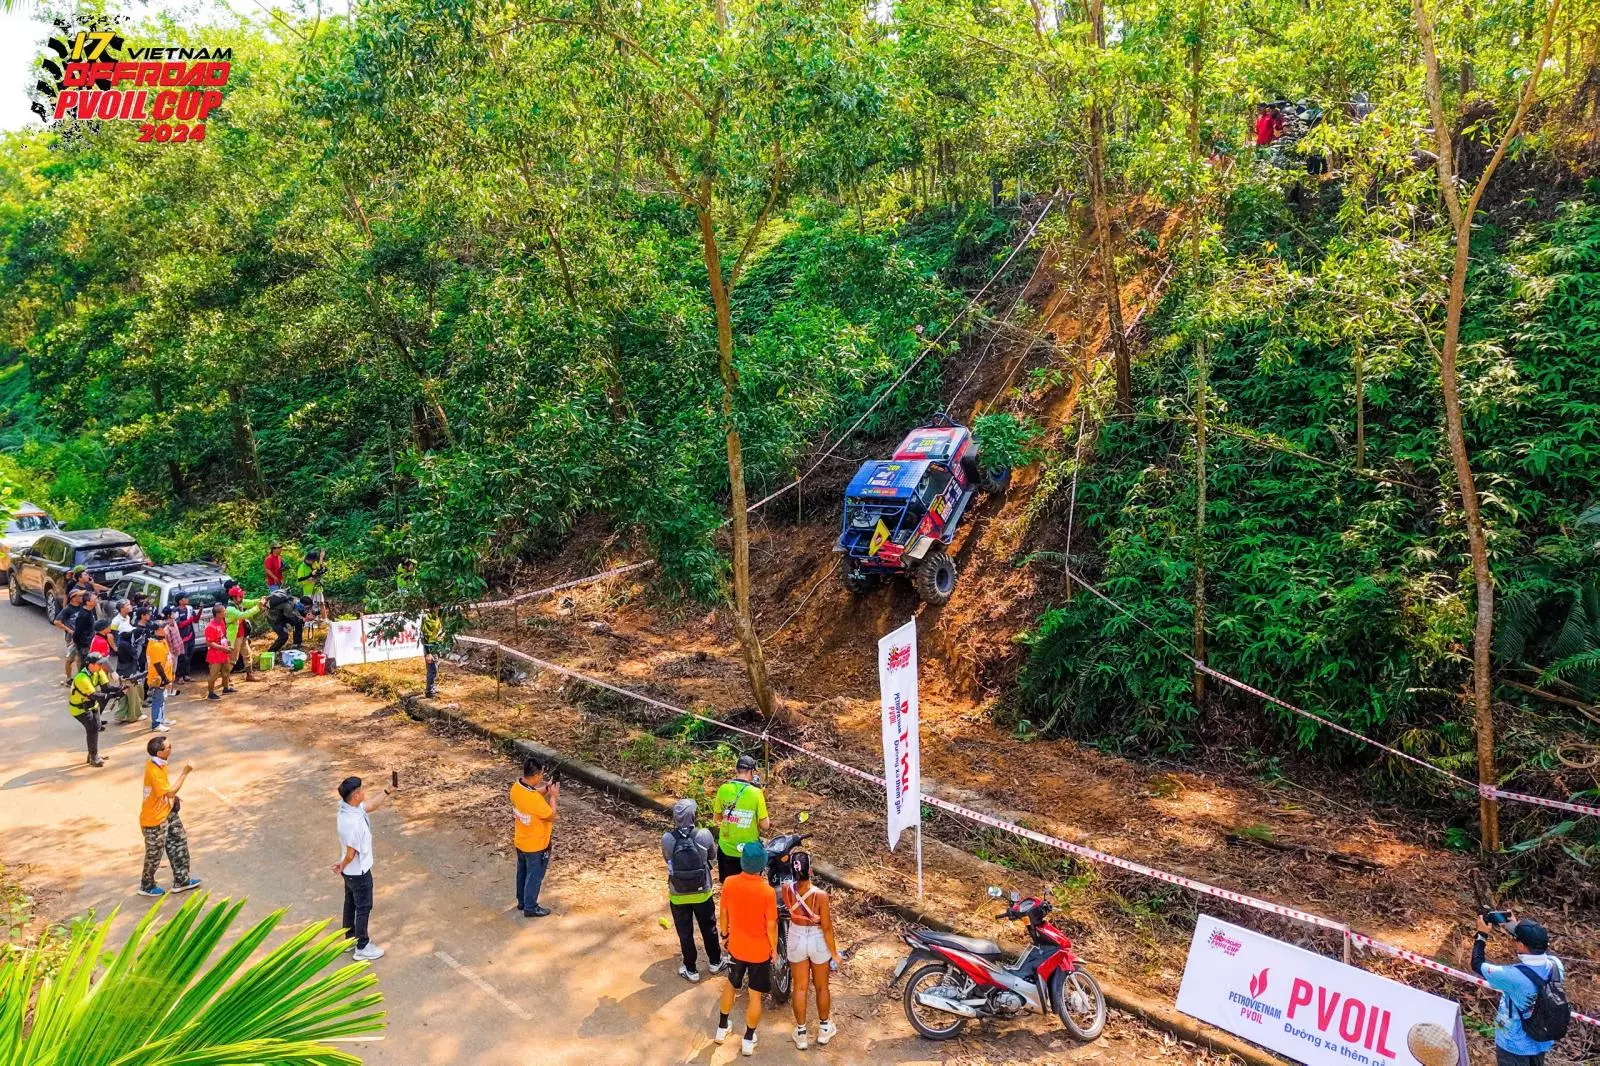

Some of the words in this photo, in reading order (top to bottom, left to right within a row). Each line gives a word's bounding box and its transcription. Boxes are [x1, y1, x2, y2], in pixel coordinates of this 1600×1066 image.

[1228, 991, 1282, 1020] PETROVIETNAM
[1240, 1007, 1263, 1024] PVOIL
[1286, 977, 1397, 1060] PVOIL
[1324, 1040, 1338, 1052] xa
[1340, 1045, 1369, 1064] thêm
